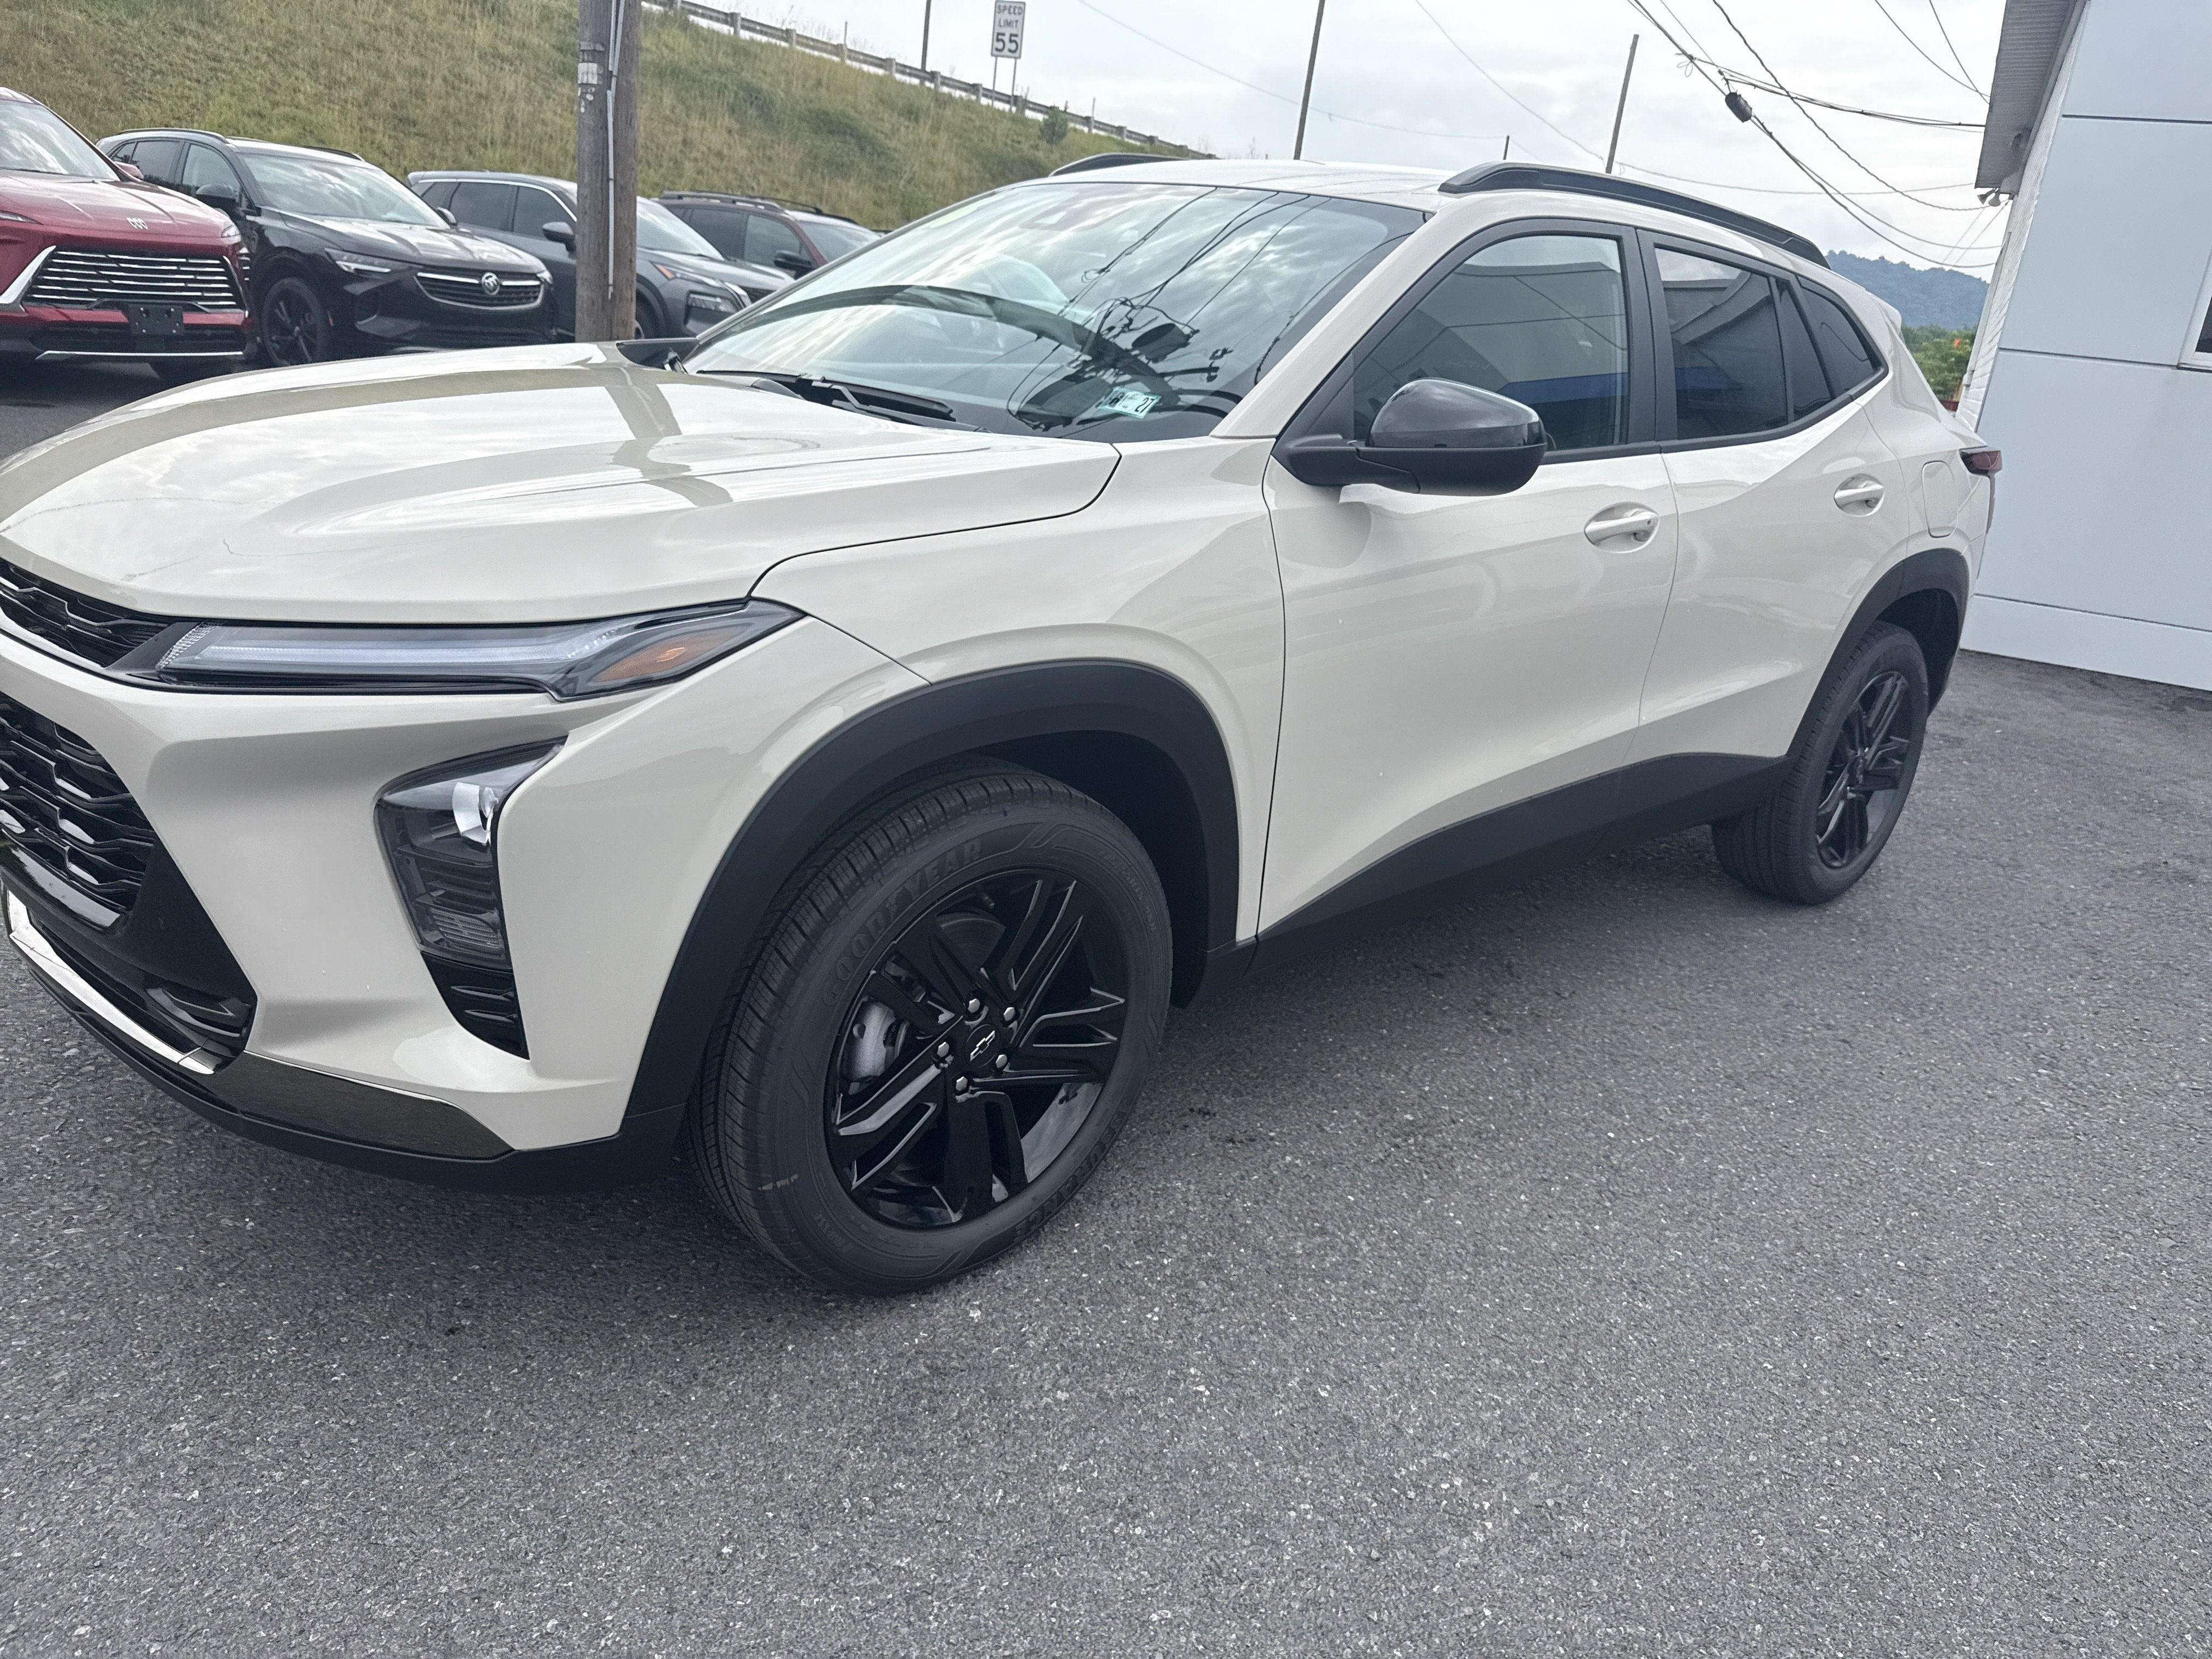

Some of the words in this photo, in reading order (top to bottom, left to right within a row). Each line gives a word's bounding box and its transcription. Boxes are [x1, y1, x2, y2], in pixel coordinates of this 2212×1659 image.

[996, 4, 1023, 15] SPEED
[997, 18, 1019, 28] LIMIT
[995, 32, 1019, 54] 55
[1134, 397, 1155, 414] 27
[822, 839, 983, 1006] GOODYEAR
